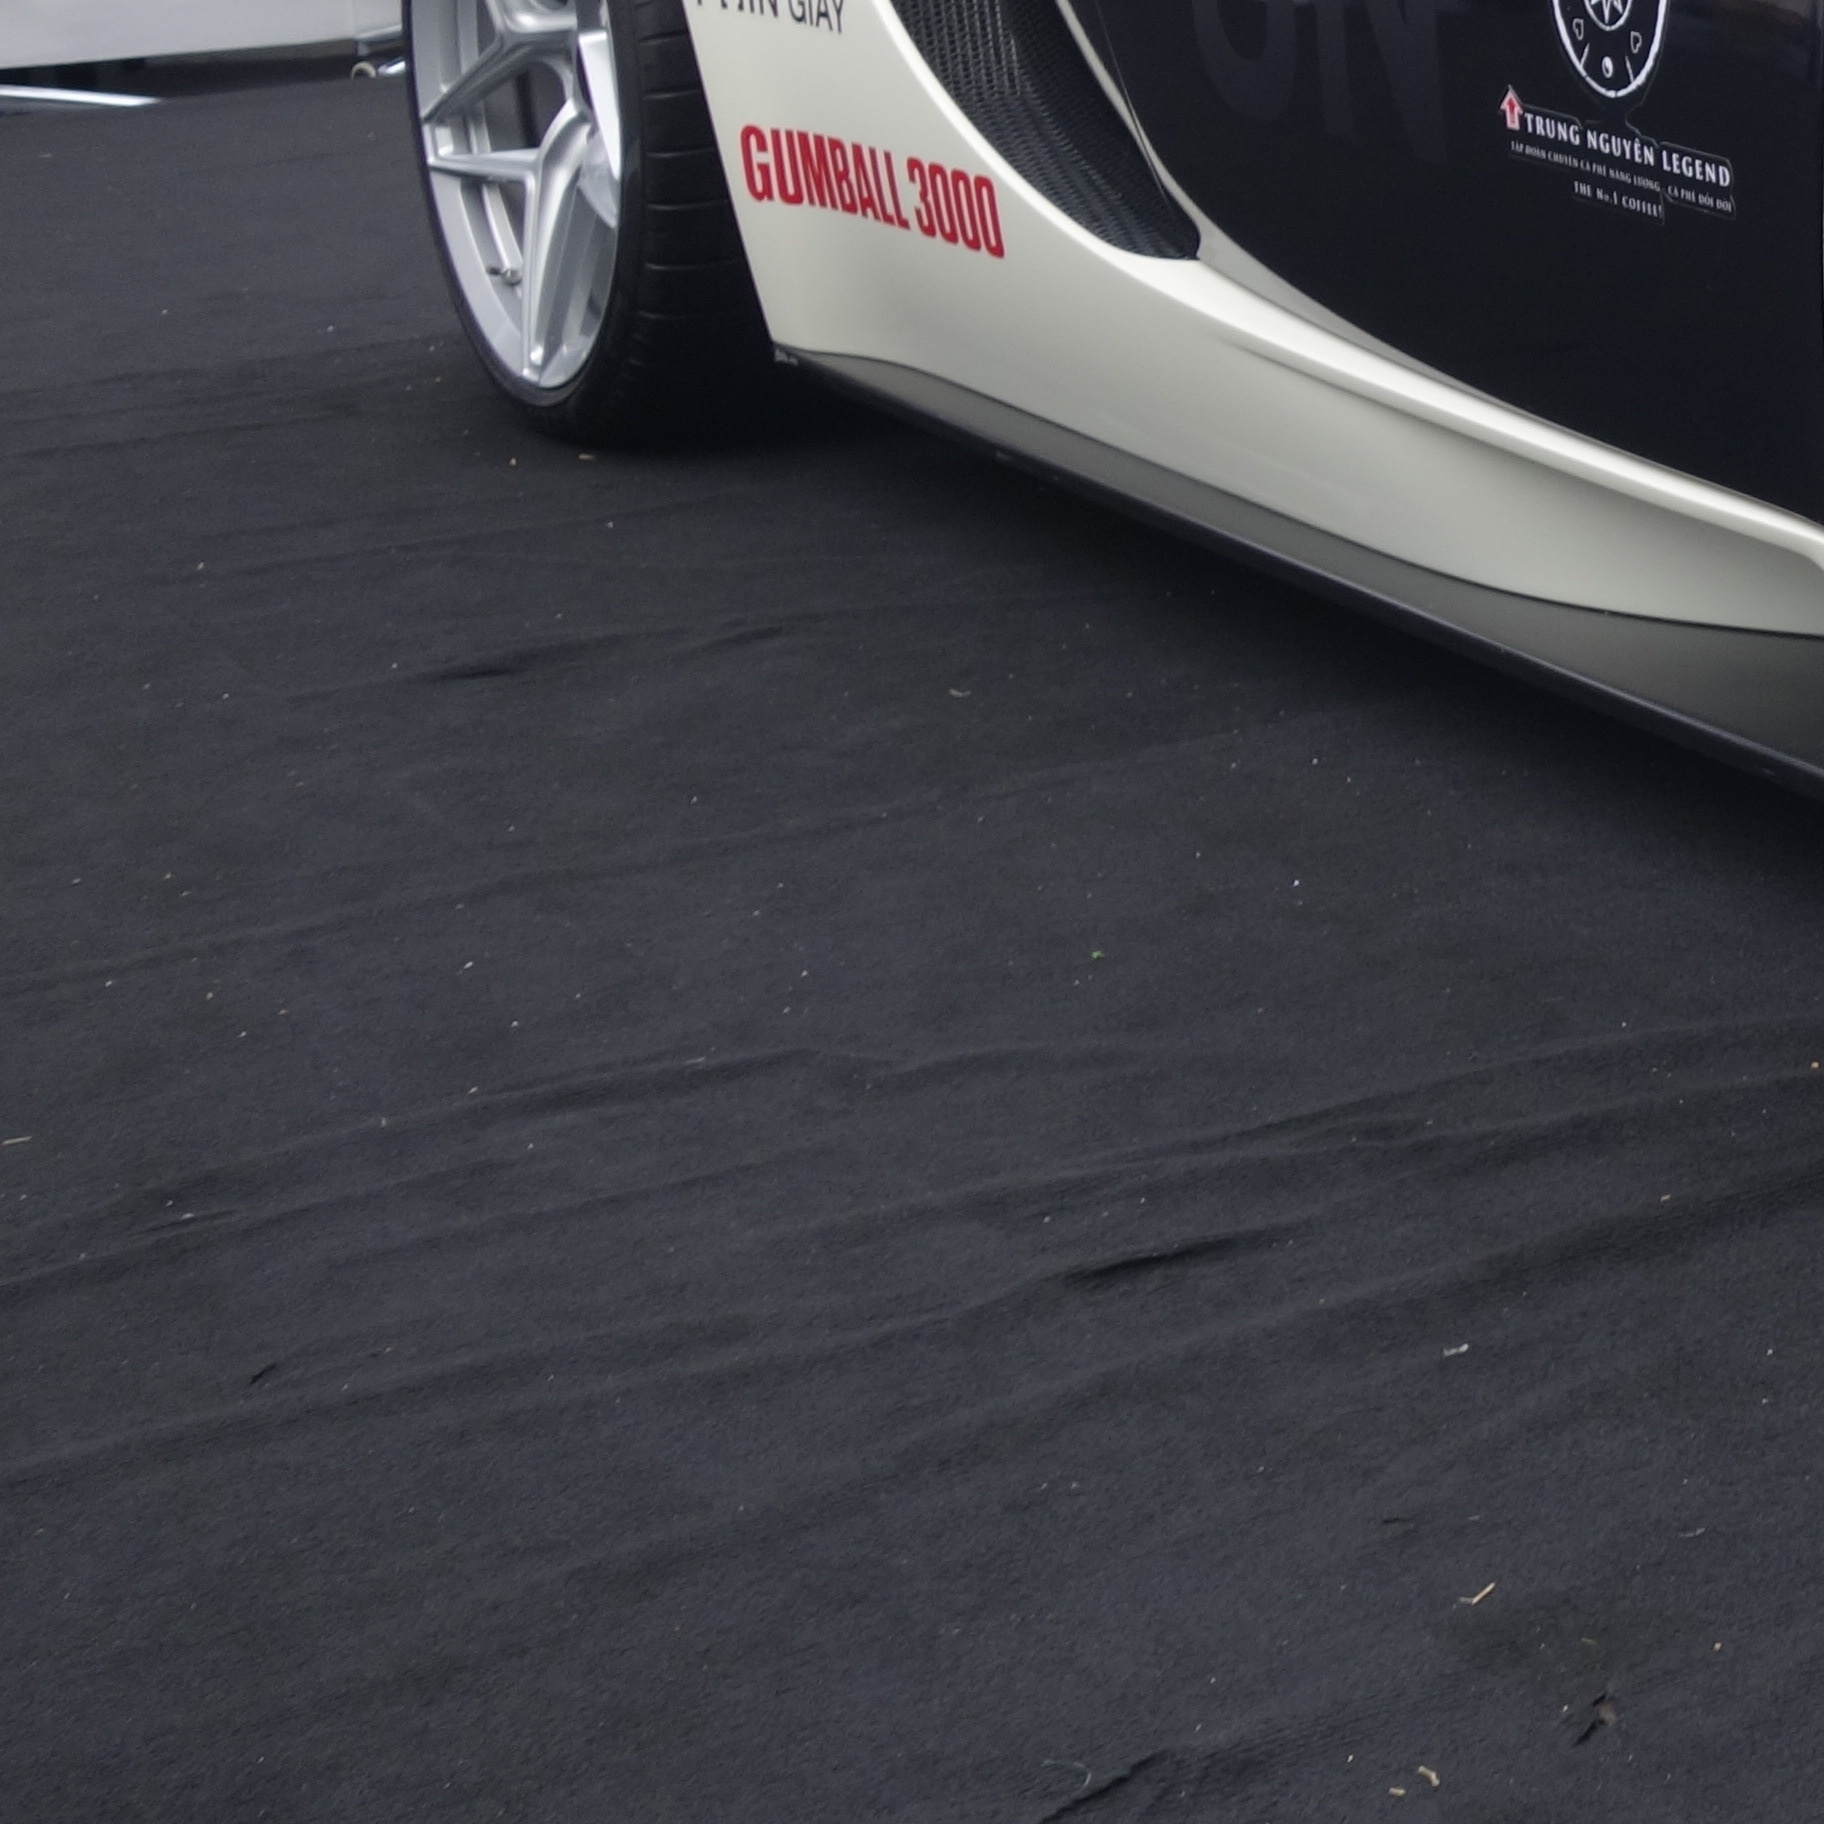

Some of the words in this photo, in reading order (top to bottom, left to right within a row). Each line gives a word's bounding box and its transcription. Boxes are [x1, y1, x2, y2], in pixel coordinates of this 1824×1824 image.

[1525, 112, 1581, 146] TRUNG
[1586, 128, 1655, 167] NGUYÊN
[1662, 149, 1732, 188] LEGEND
[740, 123, 911, 231] GUMBALL
[907, 155, 1006, 259] 3000
[1573, 180, 1593, 198] THE
